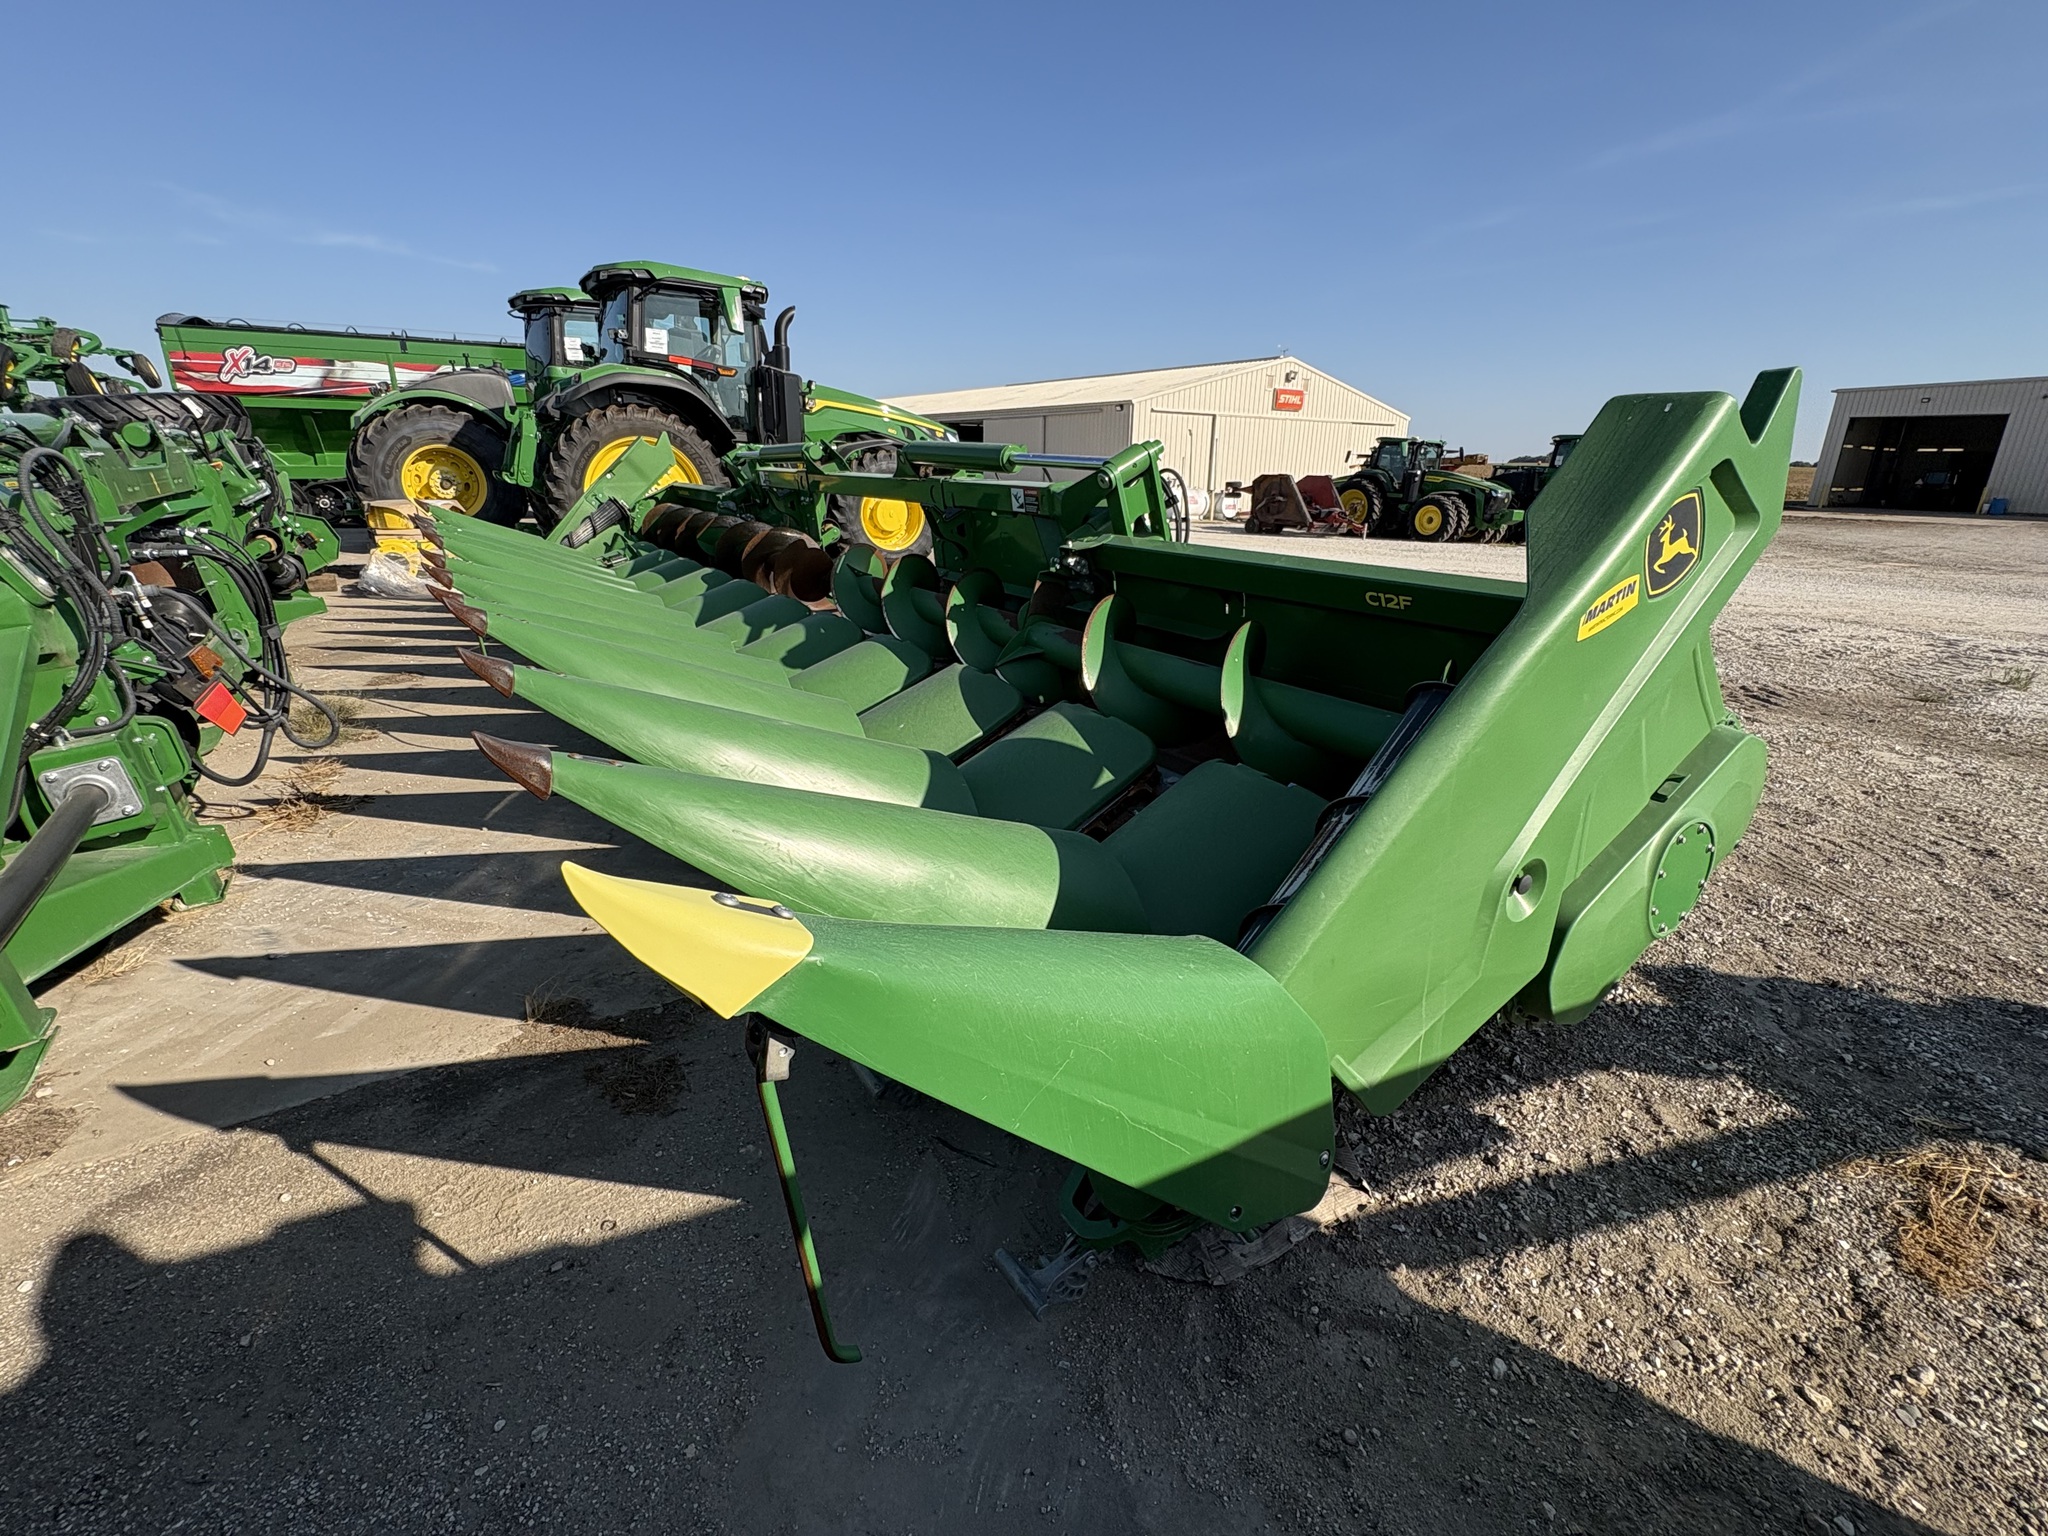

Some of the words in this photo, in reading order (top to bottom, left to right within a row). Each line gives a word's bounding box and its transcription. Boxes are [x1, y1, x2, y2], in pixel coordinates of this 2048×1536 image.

[221, 347, 272, 380] X14
[1278, 394, 1302, 405] STIHL
[1365, 591, 1413, 610] C12F
[1584, 580, 1637, 624] MARTIN
